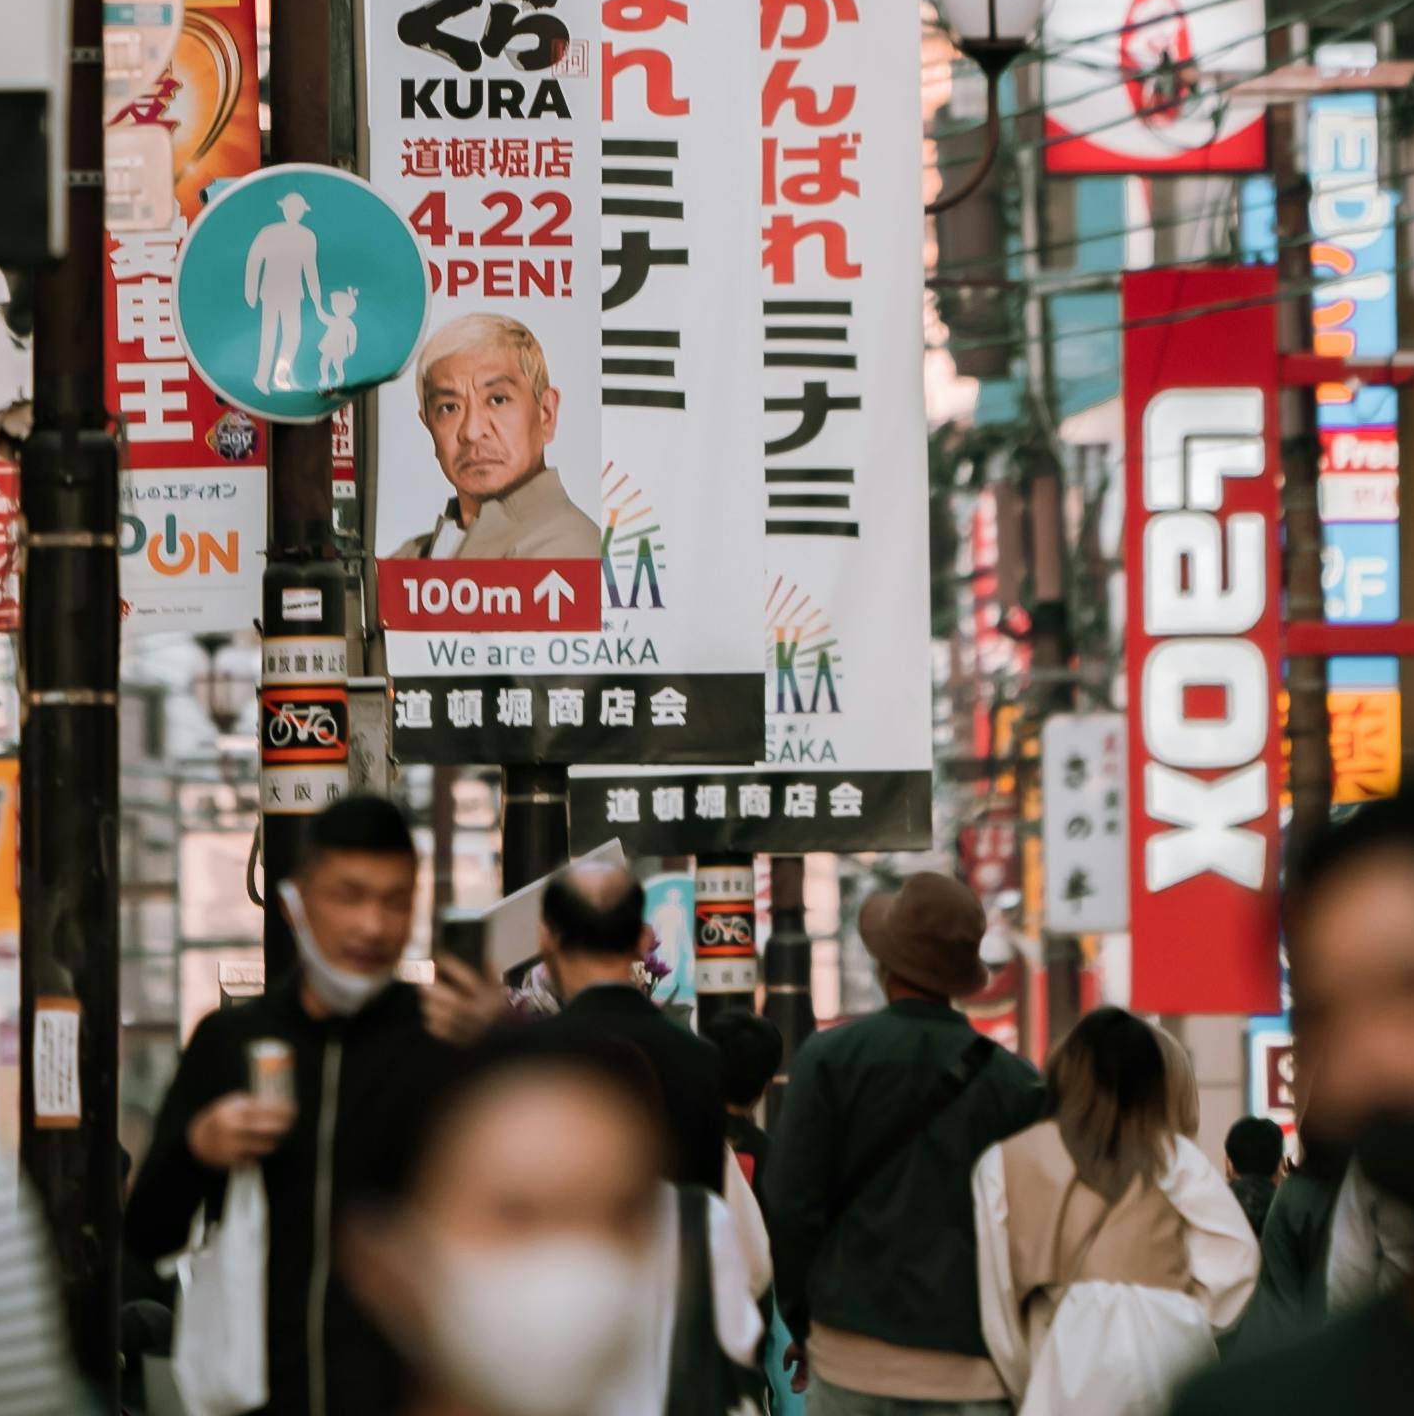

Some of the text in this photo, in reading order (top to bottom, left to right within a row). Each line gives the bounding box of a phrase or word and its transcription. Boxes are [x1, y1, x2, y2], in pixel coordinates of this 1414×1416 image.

[400, 78, 572, 119] KURA
[400, 137, 573, 178] 道頓堀店
[402, 578, 522, 615] 100m
[427, 636, 660, 667] We are OSAKA
[394, 687, 689, 730] 道頓堀商店会
[605, 783, 864, 824] 道頓堀商店会
